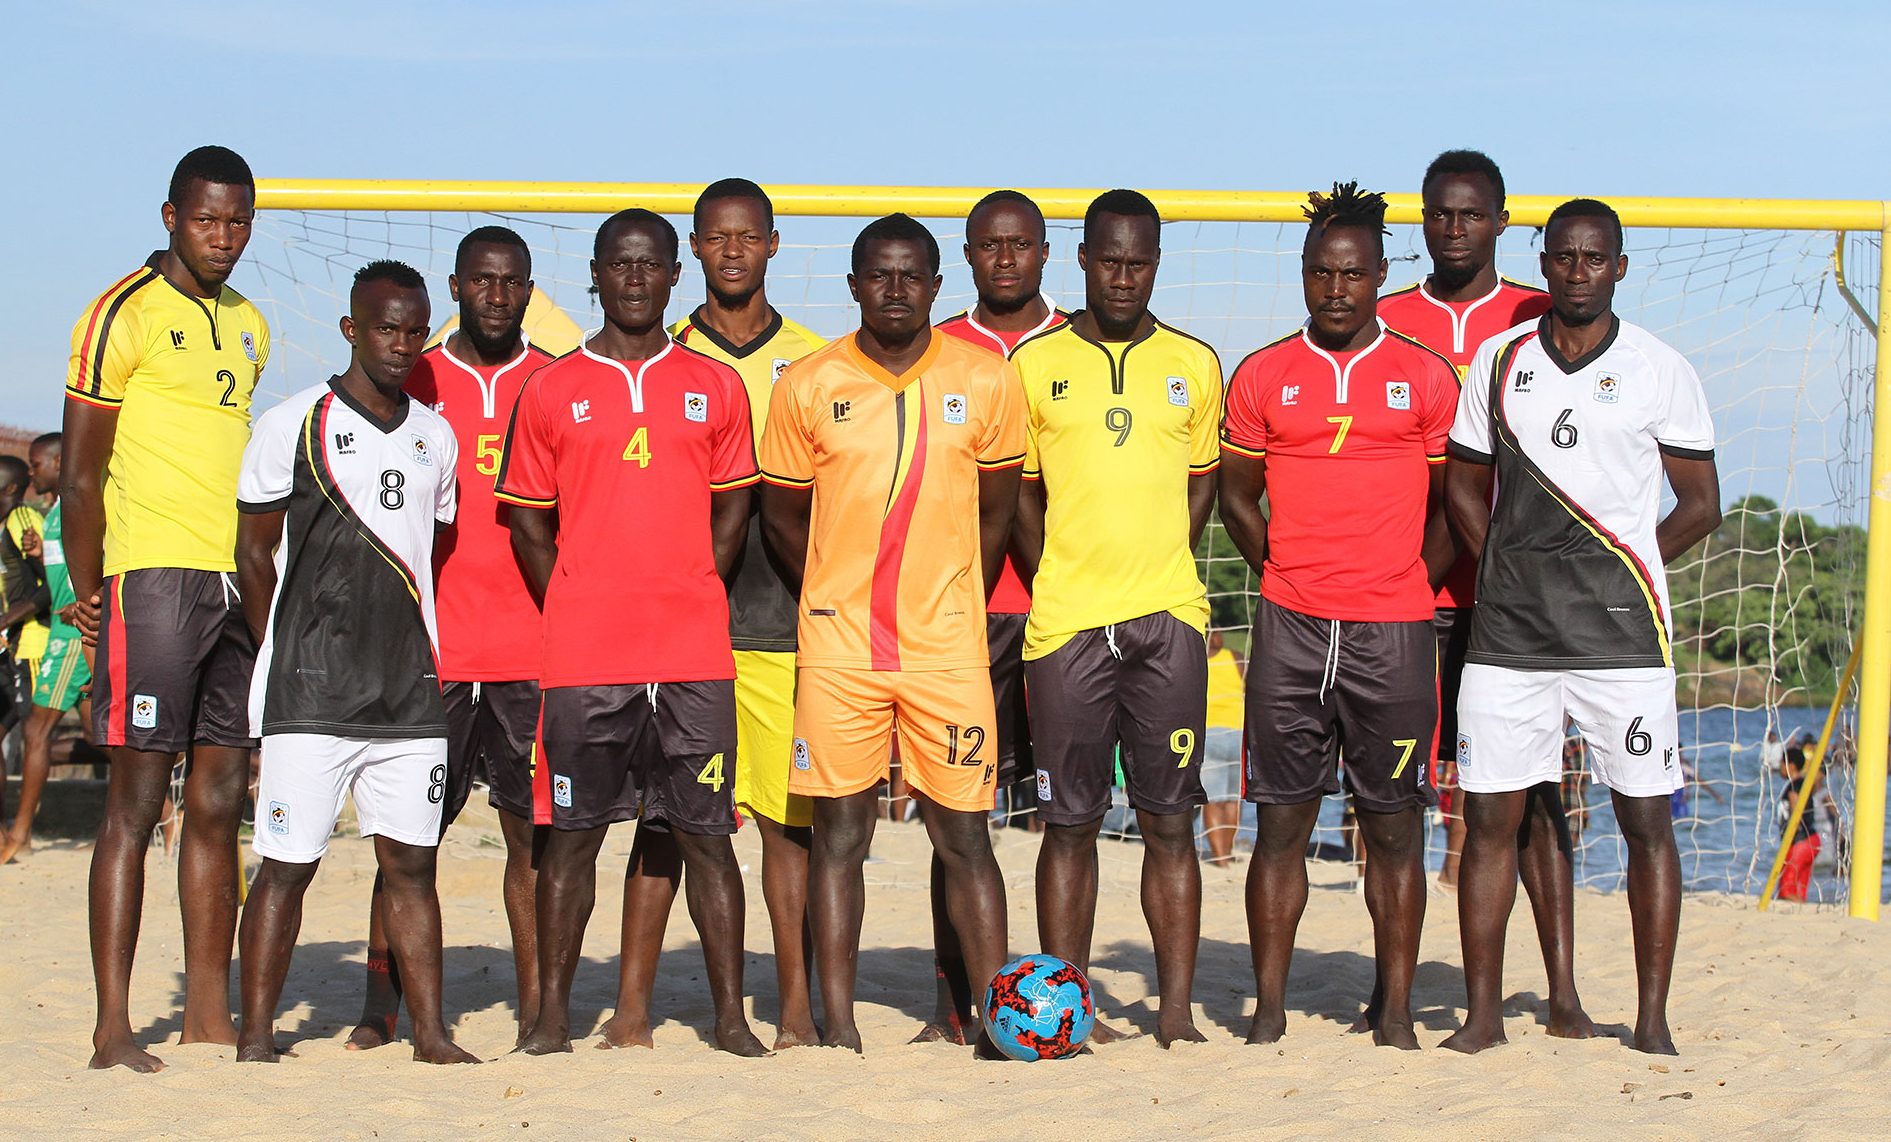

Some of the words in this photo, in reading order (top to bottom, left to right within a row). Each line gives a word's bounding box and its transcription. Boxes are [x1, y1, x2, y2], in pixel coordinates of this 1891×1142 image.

[216, 369, 238, 408] 2
[622, 426, 653, 469] 4
[1105, 407, 1133, 447] 9
[1326, 416, 1354, 454] 7
[1550, 408, 1578, 449] 6
[476, 434, 503, 476] 5
[379, 469, 406, 511] 8
[945, 725, 986, 767] 12
[1169, 728, 1195, 769] 9
[1625, 716, 1653, 757] 6
[697, 752, 725, 793] 4
[1390, 738, 1418, 780] 7
[428, 763, 447, 805] 8
